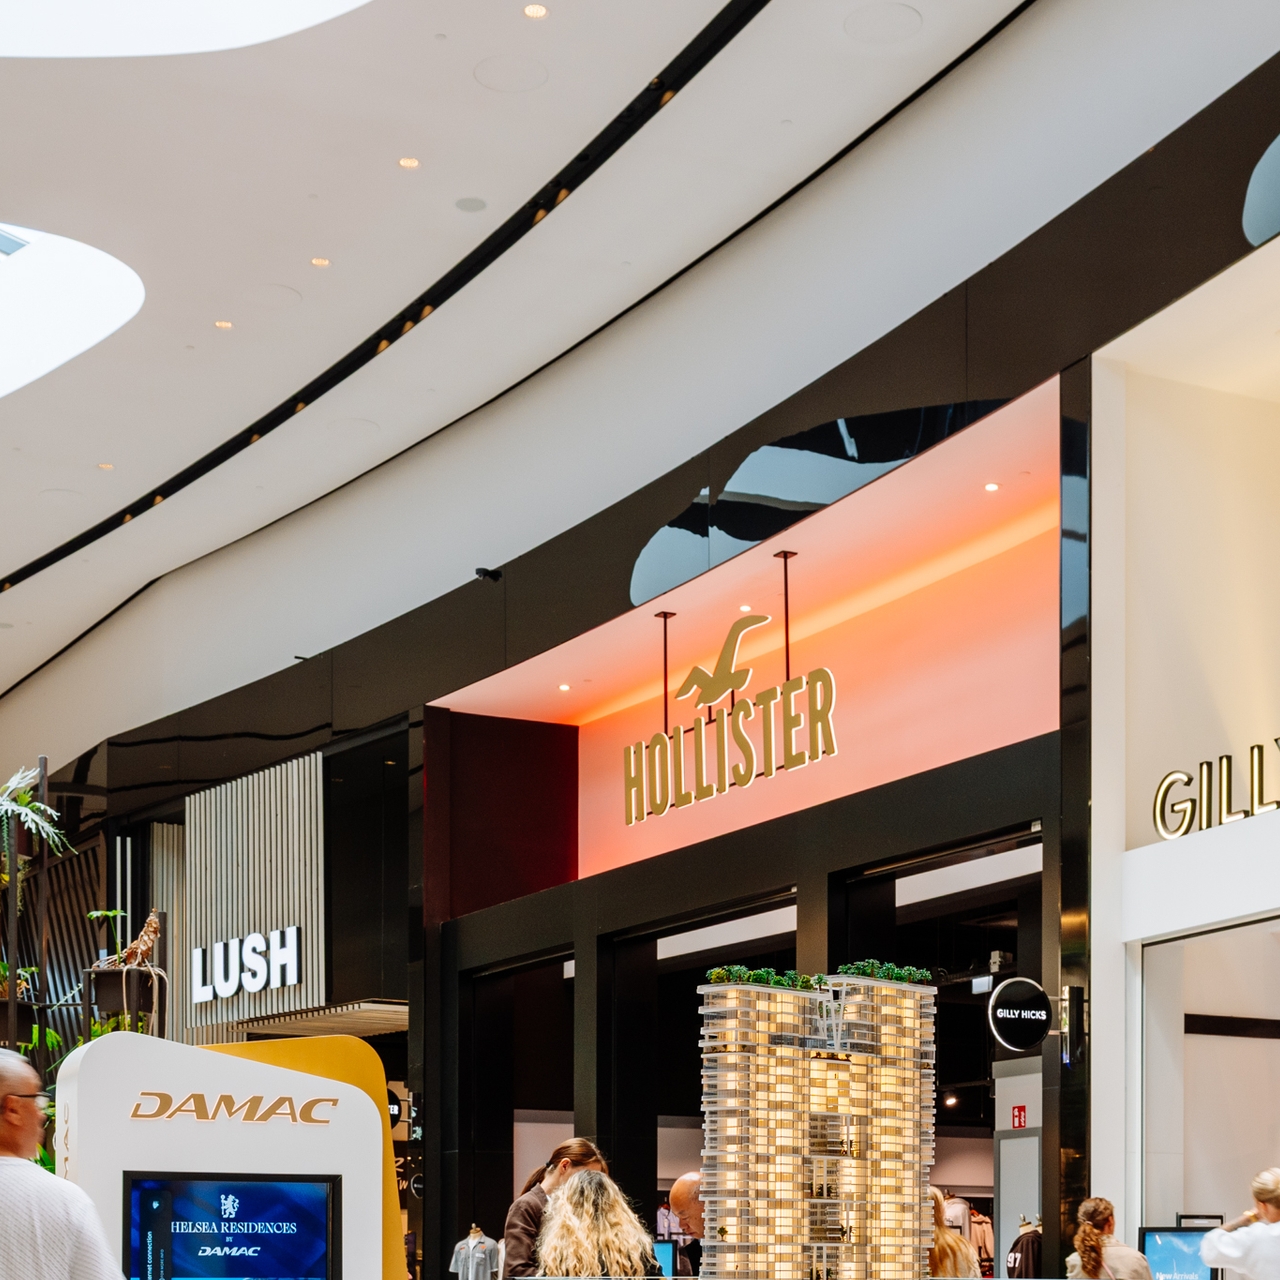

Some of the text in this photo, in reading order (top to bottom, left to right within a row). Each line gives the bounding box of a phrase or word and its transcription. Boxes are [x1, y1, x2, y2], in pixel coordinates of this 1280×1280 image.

[623, 667, 838, 826] HOLLISTER
[192, 925, 300, 1004] LUSH
[996, 1008, 1047, 1020] GILLY HICKS
[129, 1090, 338, 1125] DAMAC
[171, 1221, 297, 1234] HELSEA RESIDENCES
[198, 1246, 261, 1257] DAMAC
[1006, 1253, 1021, 1268] 97
[1173, 1271, 1199, 1280] Arrivals
